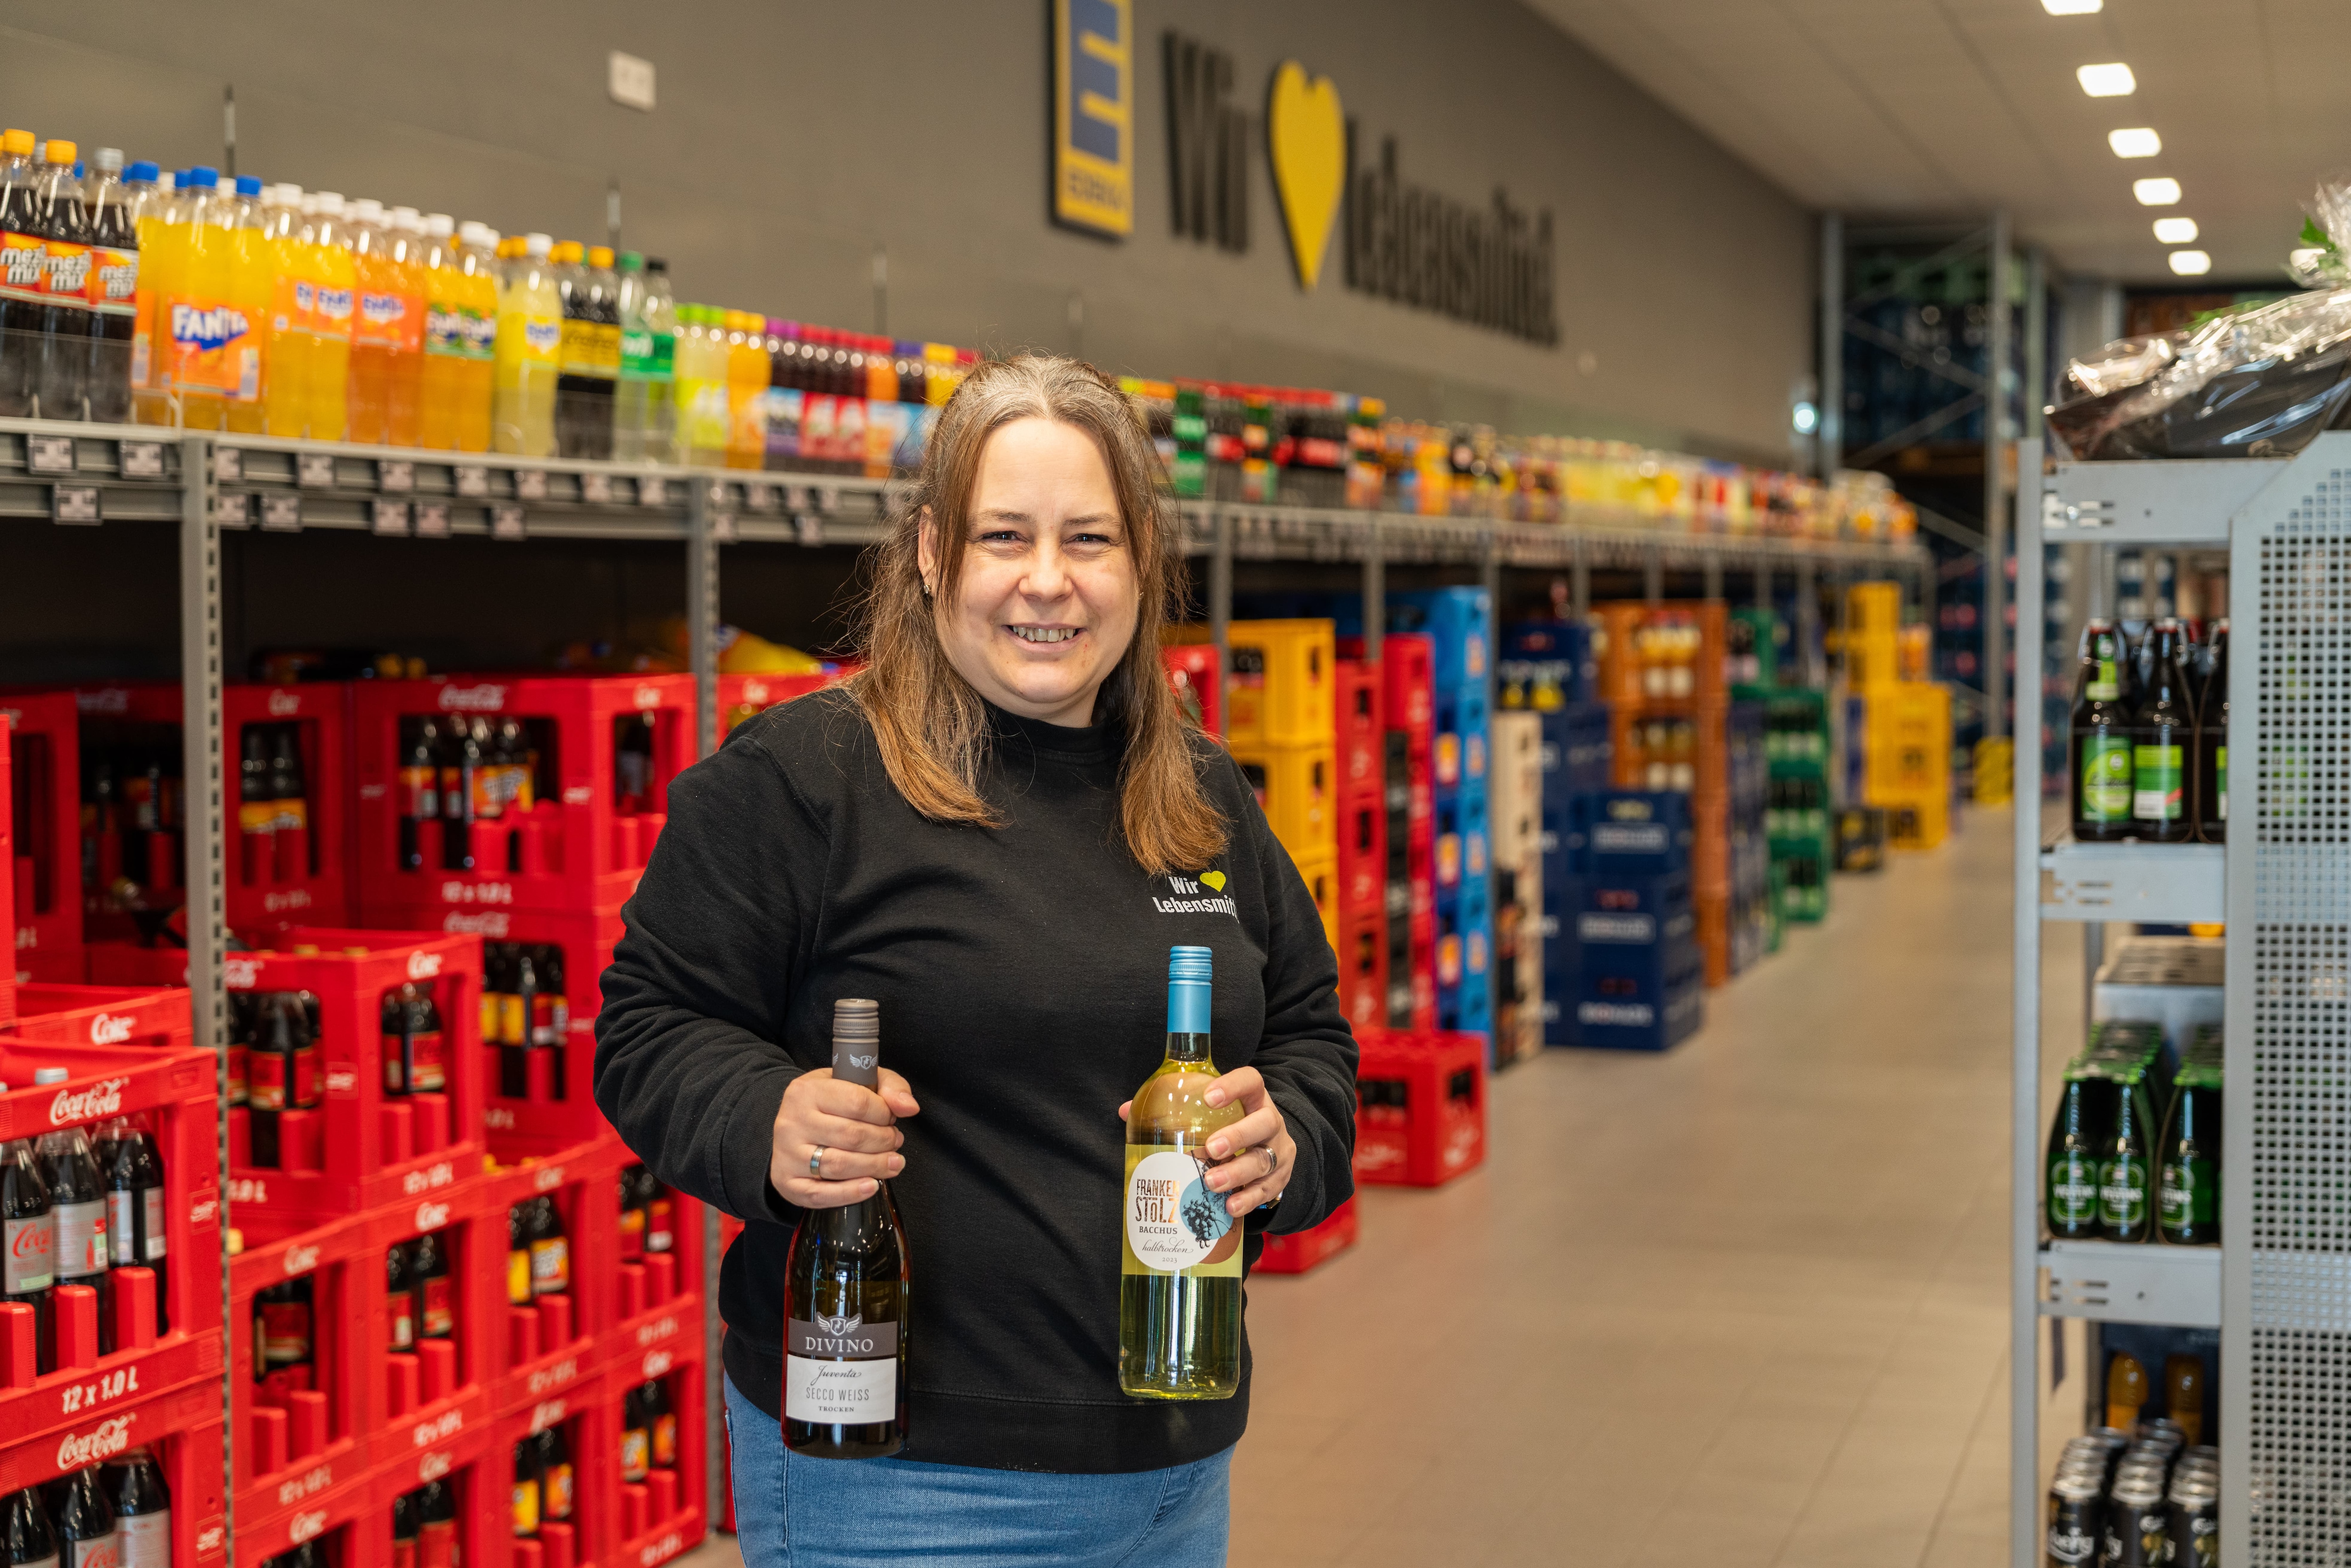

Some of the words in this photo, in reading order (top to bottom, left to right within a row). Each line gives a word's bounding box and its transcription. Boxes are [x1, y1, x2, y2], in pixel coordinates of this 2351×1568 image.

[1168, 876, 1199, 894] Wir
[1152, 895, 1240, 924] Lebensmitt
[1136, 1178, 1180, 1198] FRANKEN
[1142, 1237, 1194, 1253] halbtrocken
[805, 1336, 874, 1353] DIVINO
[811, 1365, 862, 1386] Juventa
[62, 1385, 82, 1415] 12
[84, 1385, 97, 1407] x
[126, 1365, 139, 1392] L
[806, 1387, 834, 1401] SECCO
[838, 1389, 869, 1401] WEISS
